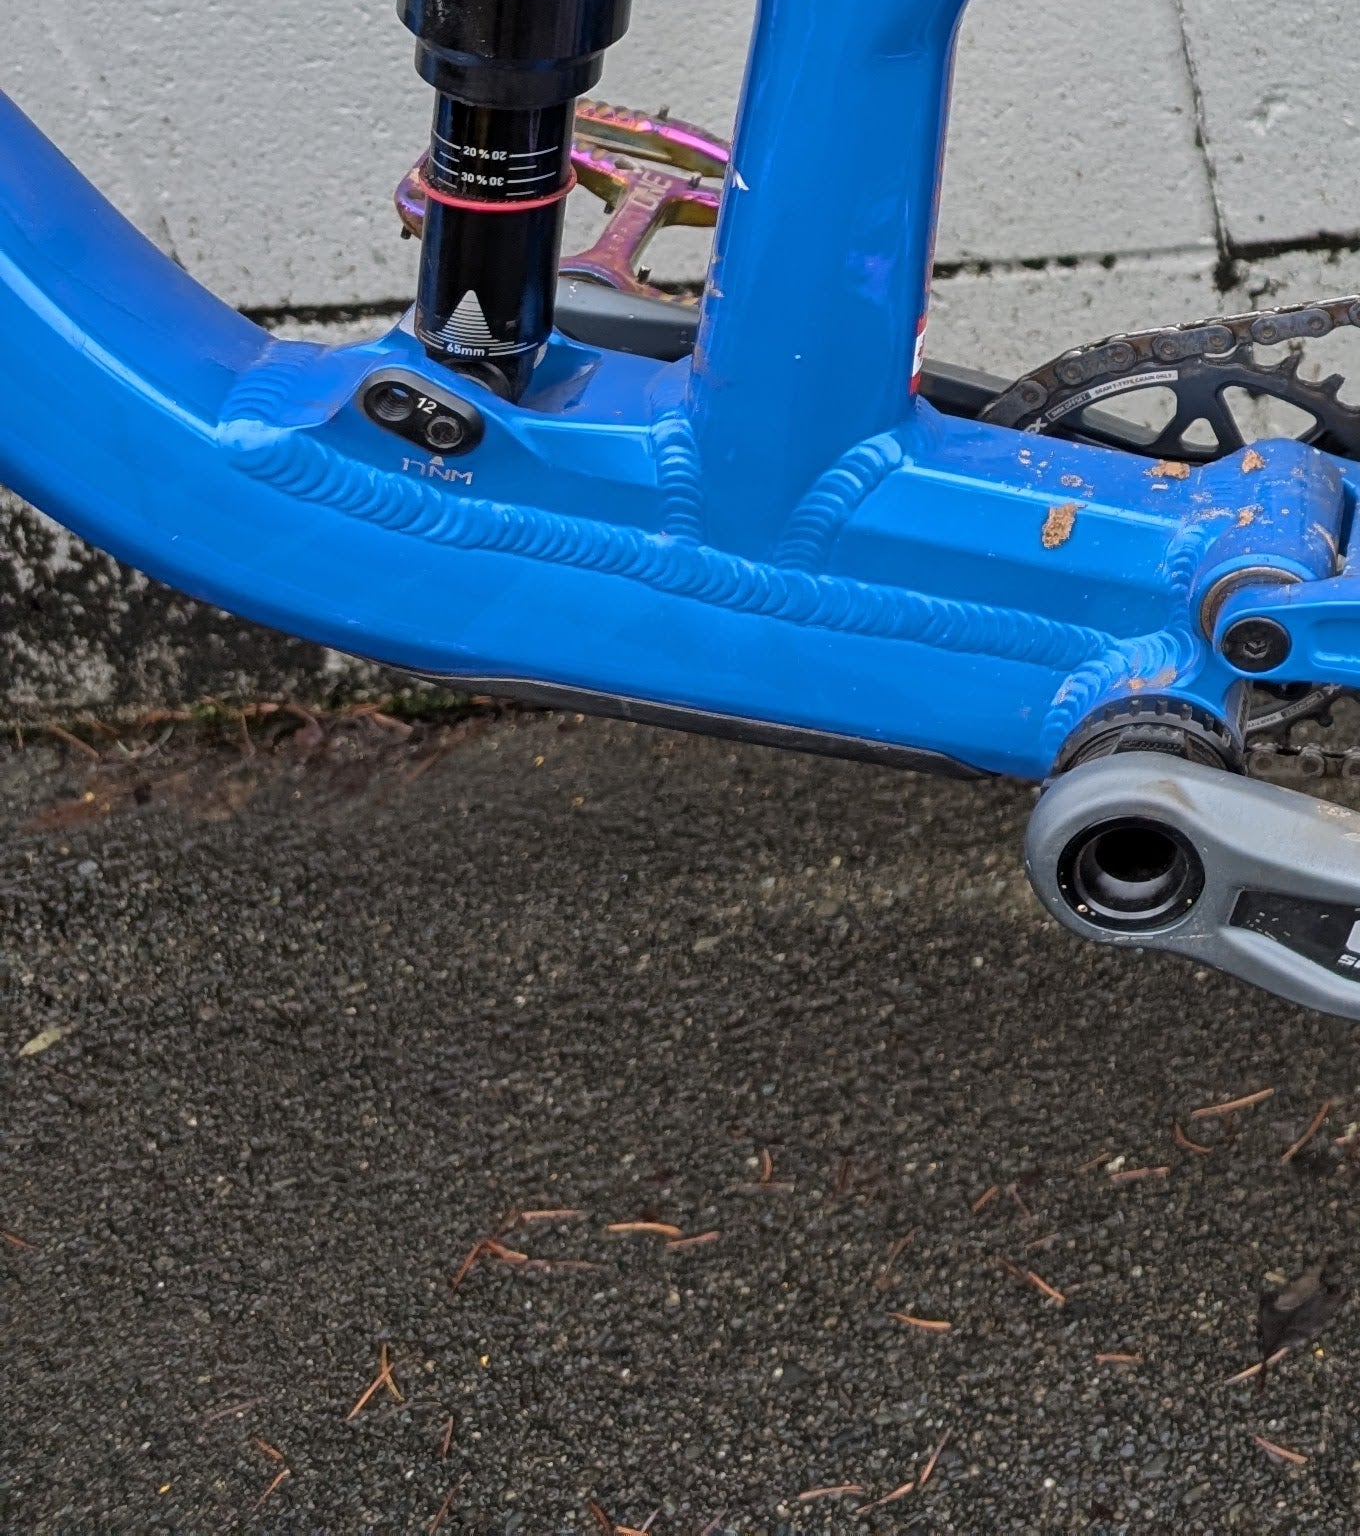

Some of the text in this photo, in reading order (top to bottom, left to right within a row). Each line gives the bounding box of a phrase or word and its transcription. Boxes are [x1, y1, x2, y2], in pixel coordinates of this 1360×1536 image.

[463, 145, 477, 157] 20
[460, 171, 475, 183] 30
[446, 342, 486, 357] 65mm
[416, 397, 438, 415] 12
